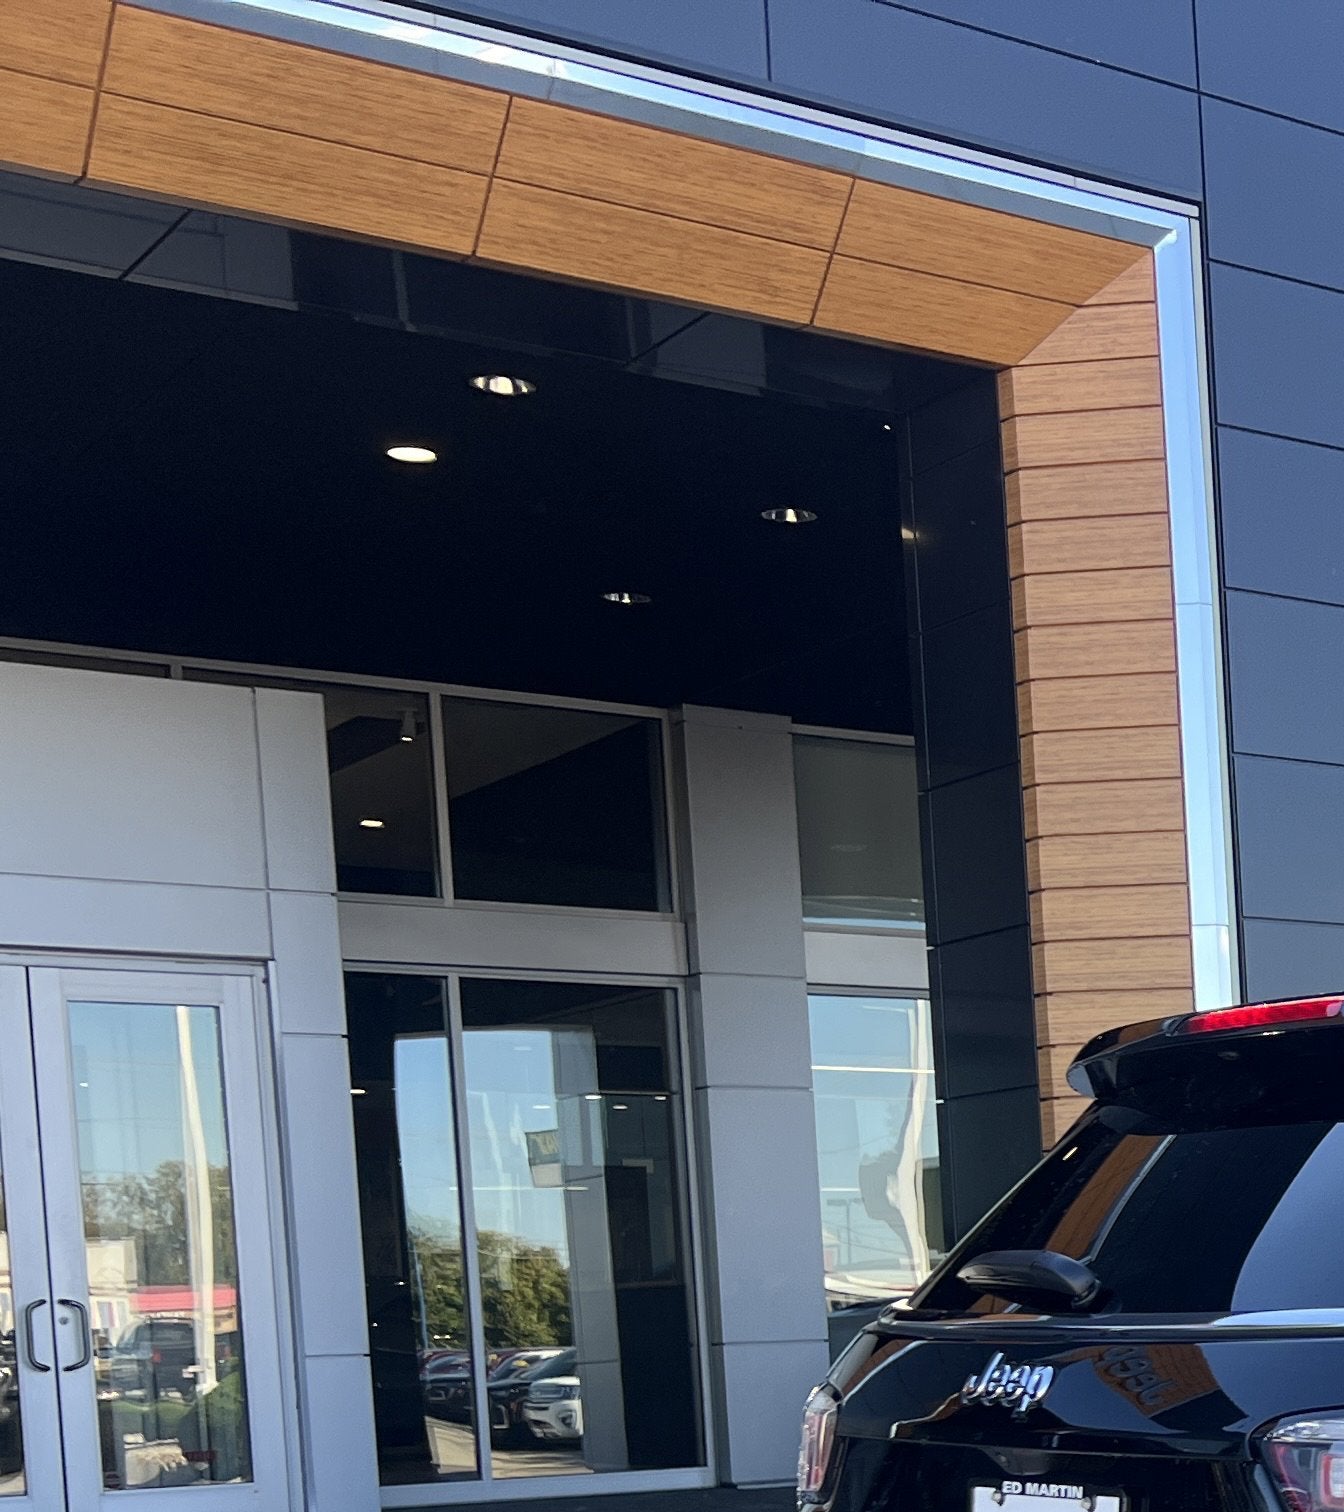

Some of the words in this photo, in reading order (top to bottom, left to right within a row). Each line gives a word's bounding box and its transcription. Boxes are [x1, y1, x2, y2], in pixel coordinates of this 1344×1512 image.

[962, 1352, 1054, 1412] Jeep
[1002, 1480, 1023, 1495] ED
[1025, 1482, 1084, 1499] MARTIN
